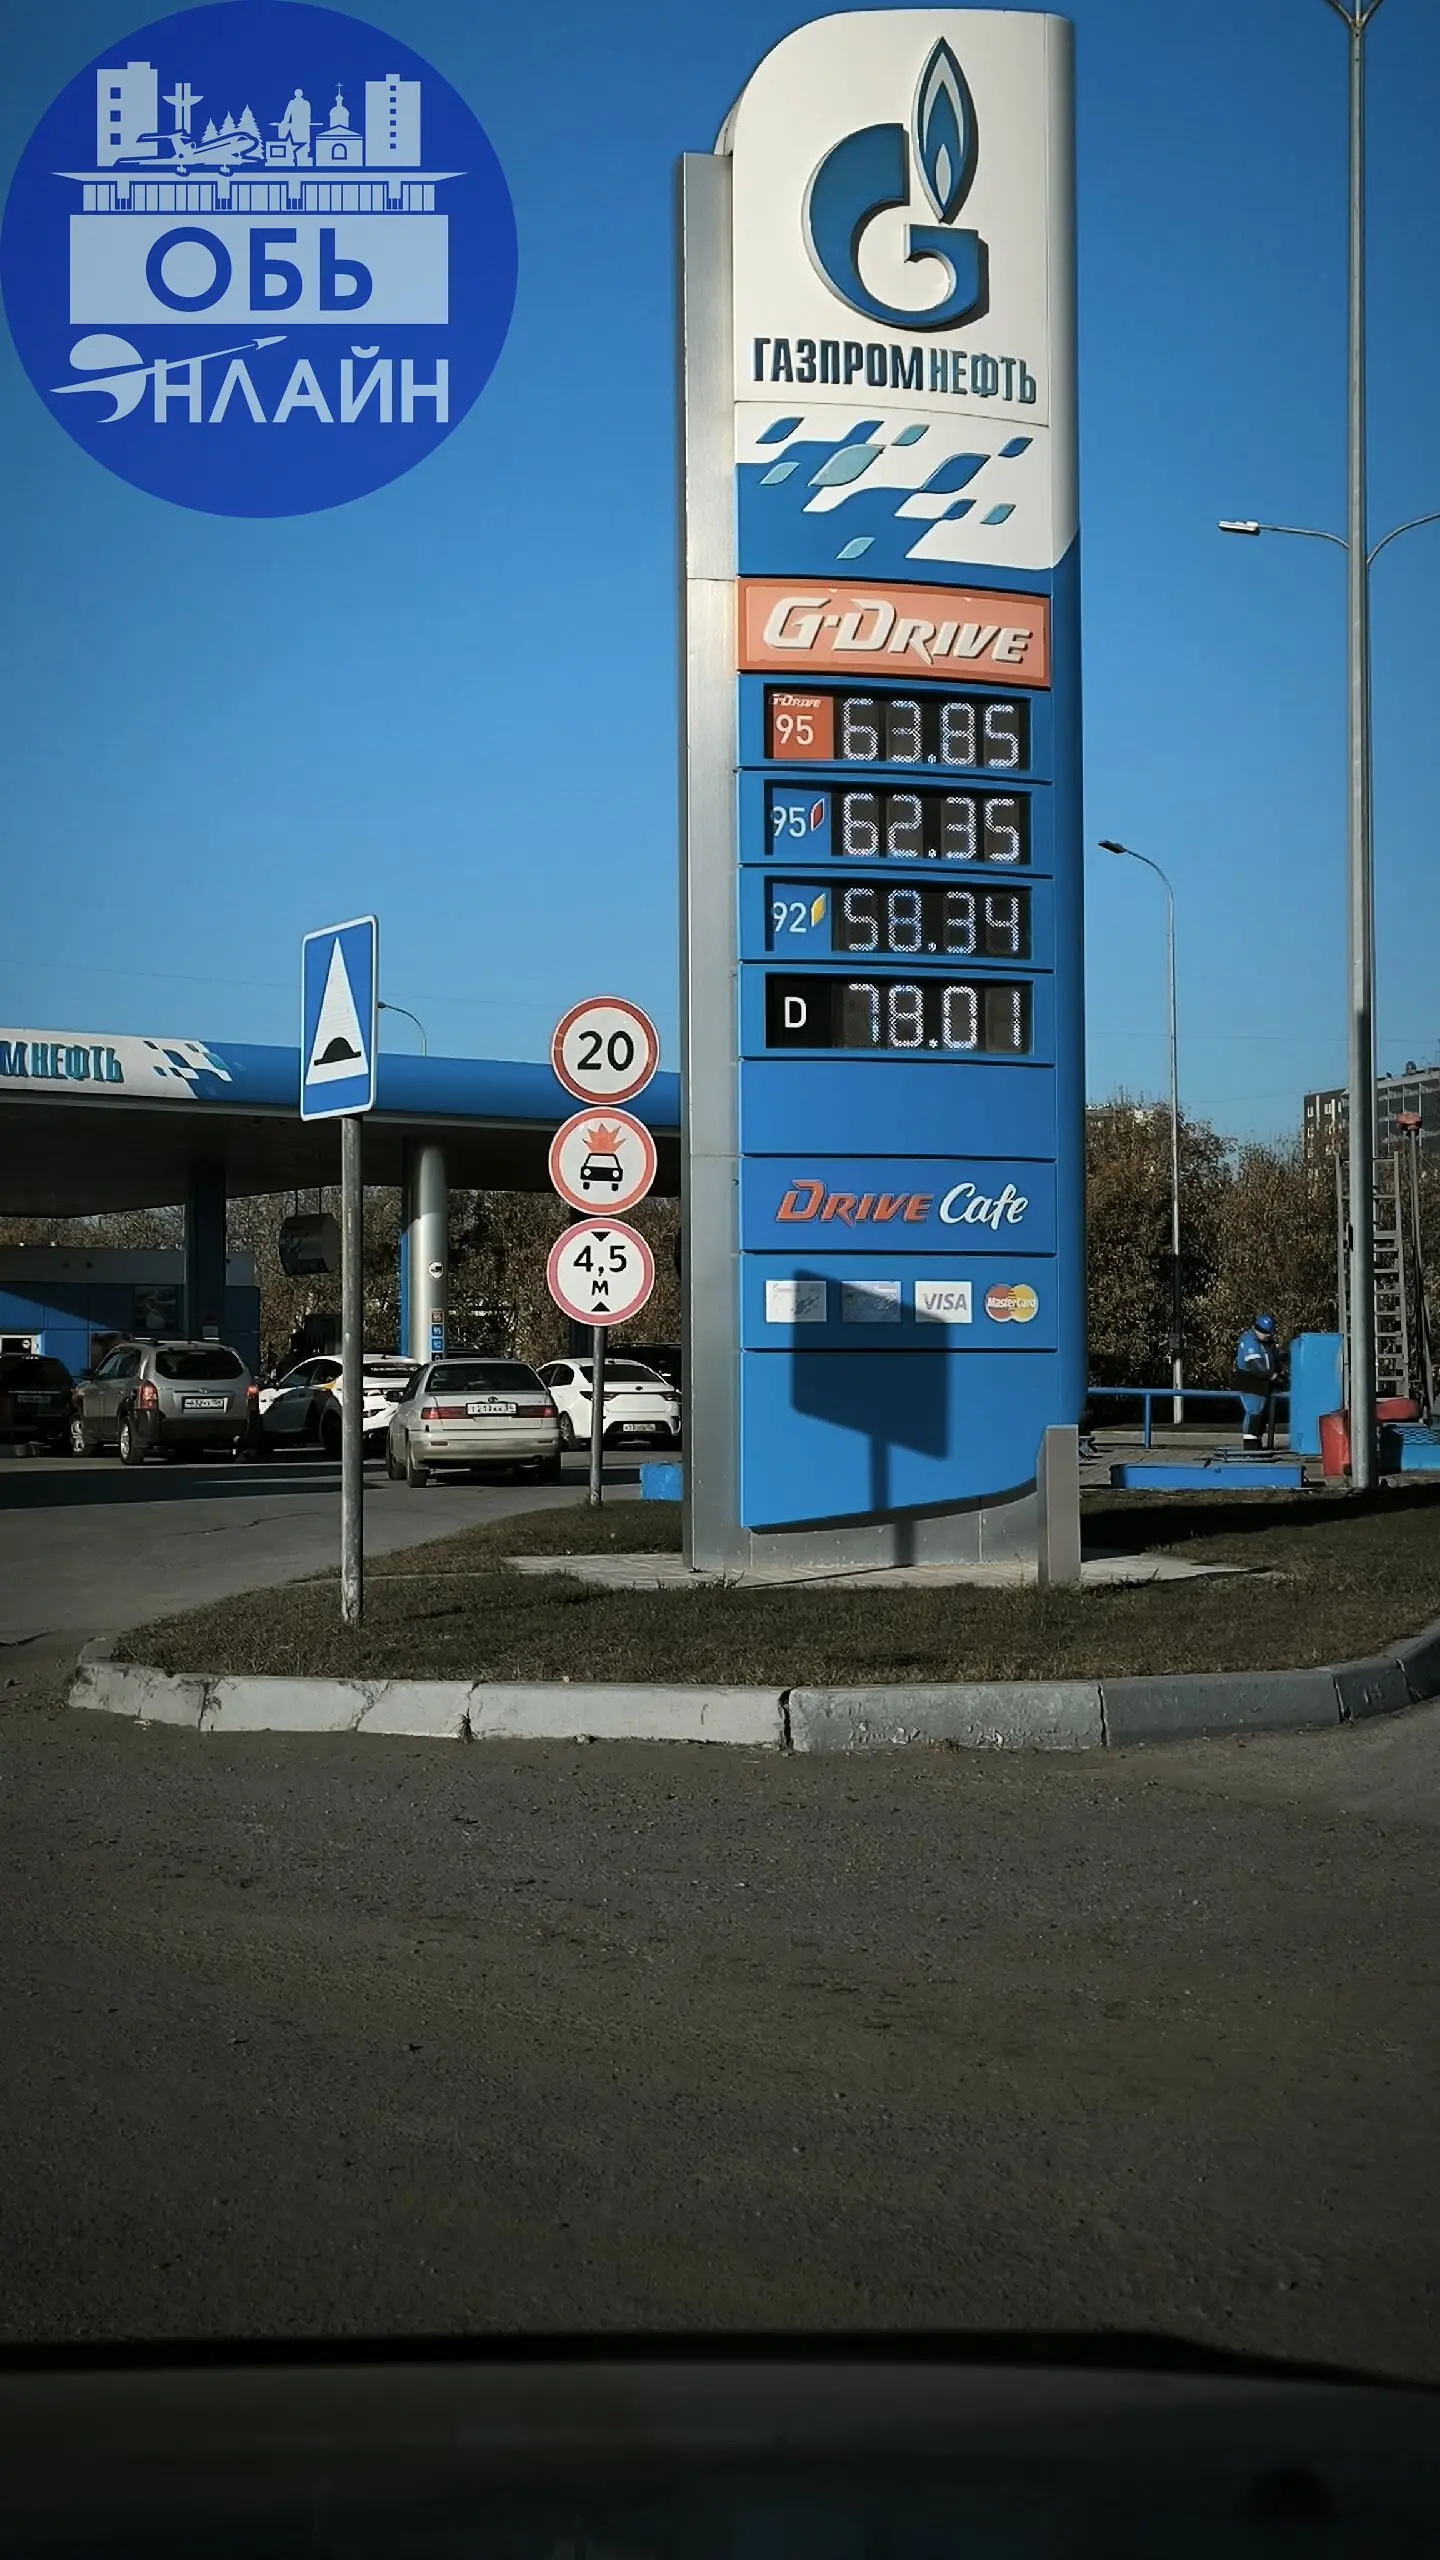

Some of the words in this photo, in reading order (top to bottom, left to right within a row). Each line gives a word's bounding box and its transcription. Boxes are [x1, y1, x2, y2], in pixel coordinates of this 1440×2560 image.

[752, 337, 1037, 405] ГАЗПРОМНЕФТЬ
[775, 713, 814, 745] 95
[843, 697, 1020, 768] 63.85
[771, 806, 807, 837] 95
[843, 792, 1020, 862] 62.35
[771, 901, 807, 933] 92
[843, 887, 1020, 954] 58.34
[784, 996, 807, 1028] D
[848, 983, 1022, 1048] 78.01
[577, 1030, 634, 1071] 20
[938, 1182, 1029, 1231] Cafe
[573, 1245, 627, 1277] 4,5
[921, 1293, 967, 1310] VISA
